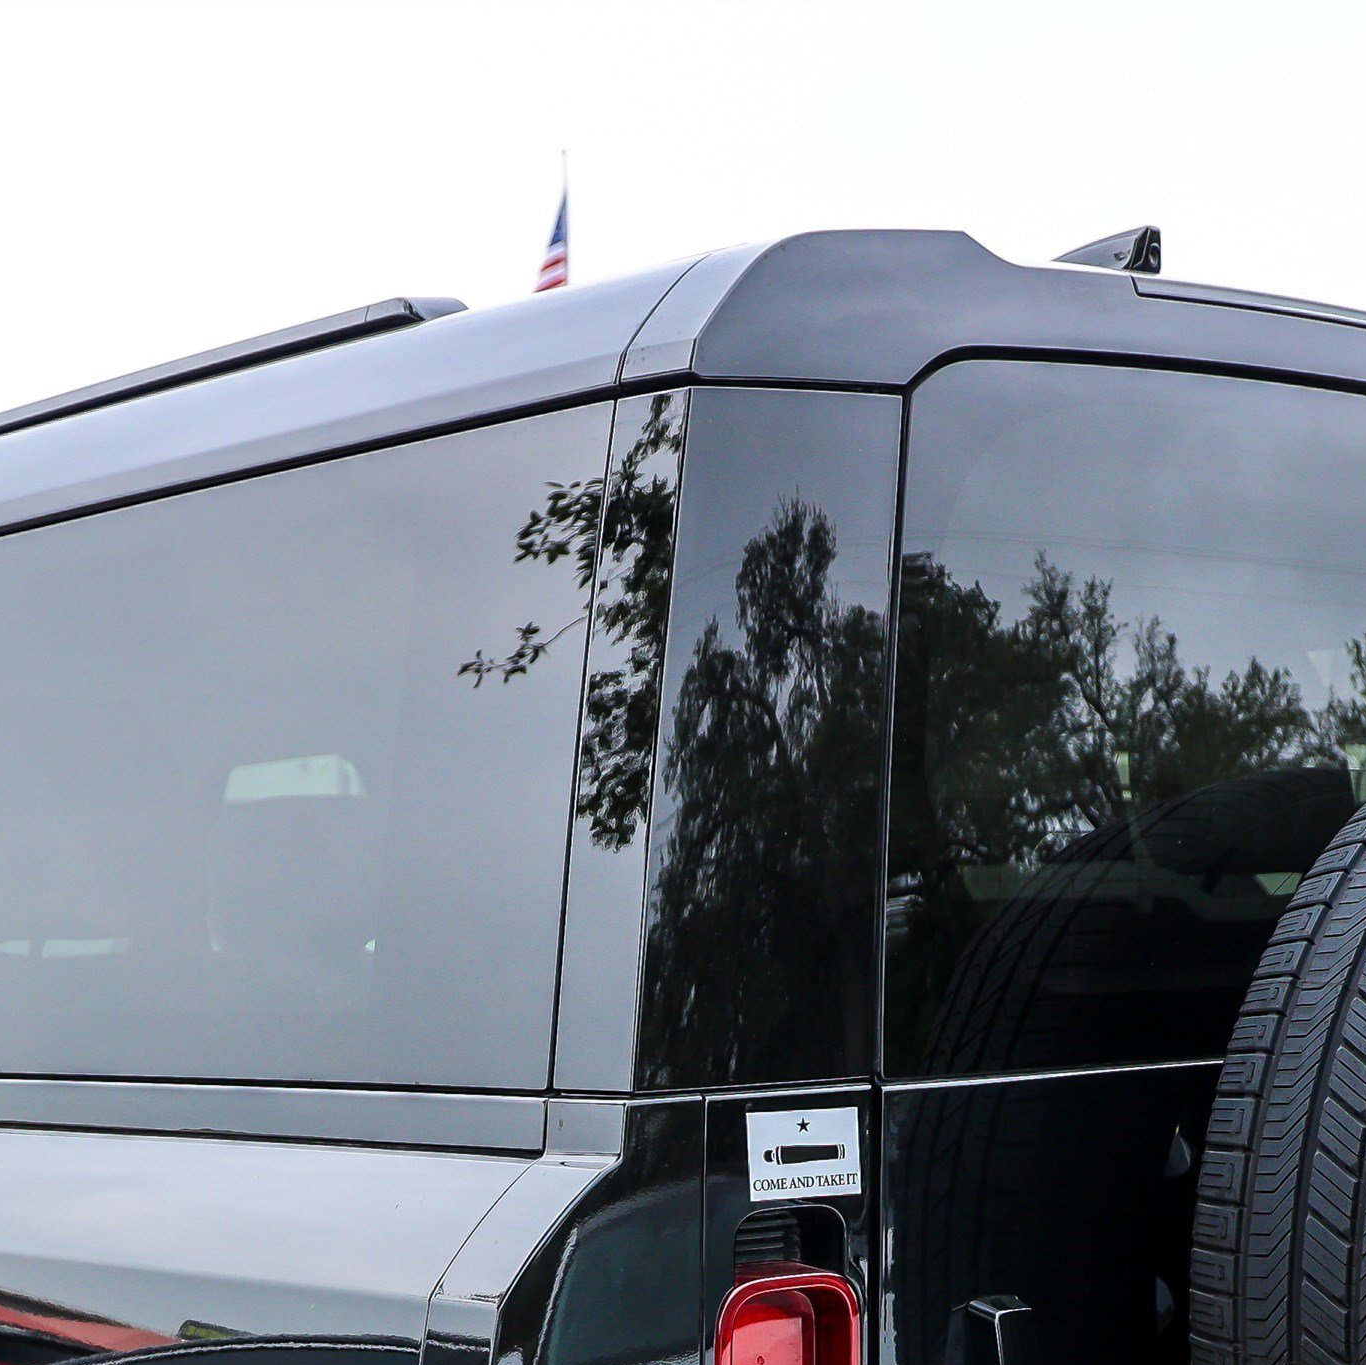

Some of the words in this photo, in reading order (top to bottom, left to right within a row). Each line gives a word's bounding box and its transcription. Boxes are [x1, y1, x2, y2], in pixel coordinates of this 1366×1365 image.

[752, 1178, 787, 1192] COME
[789, 1175, 815, 1190] AND
[816, 1173, 845, 1187] TAKE
[846, 1172, 858, 1185] IT
